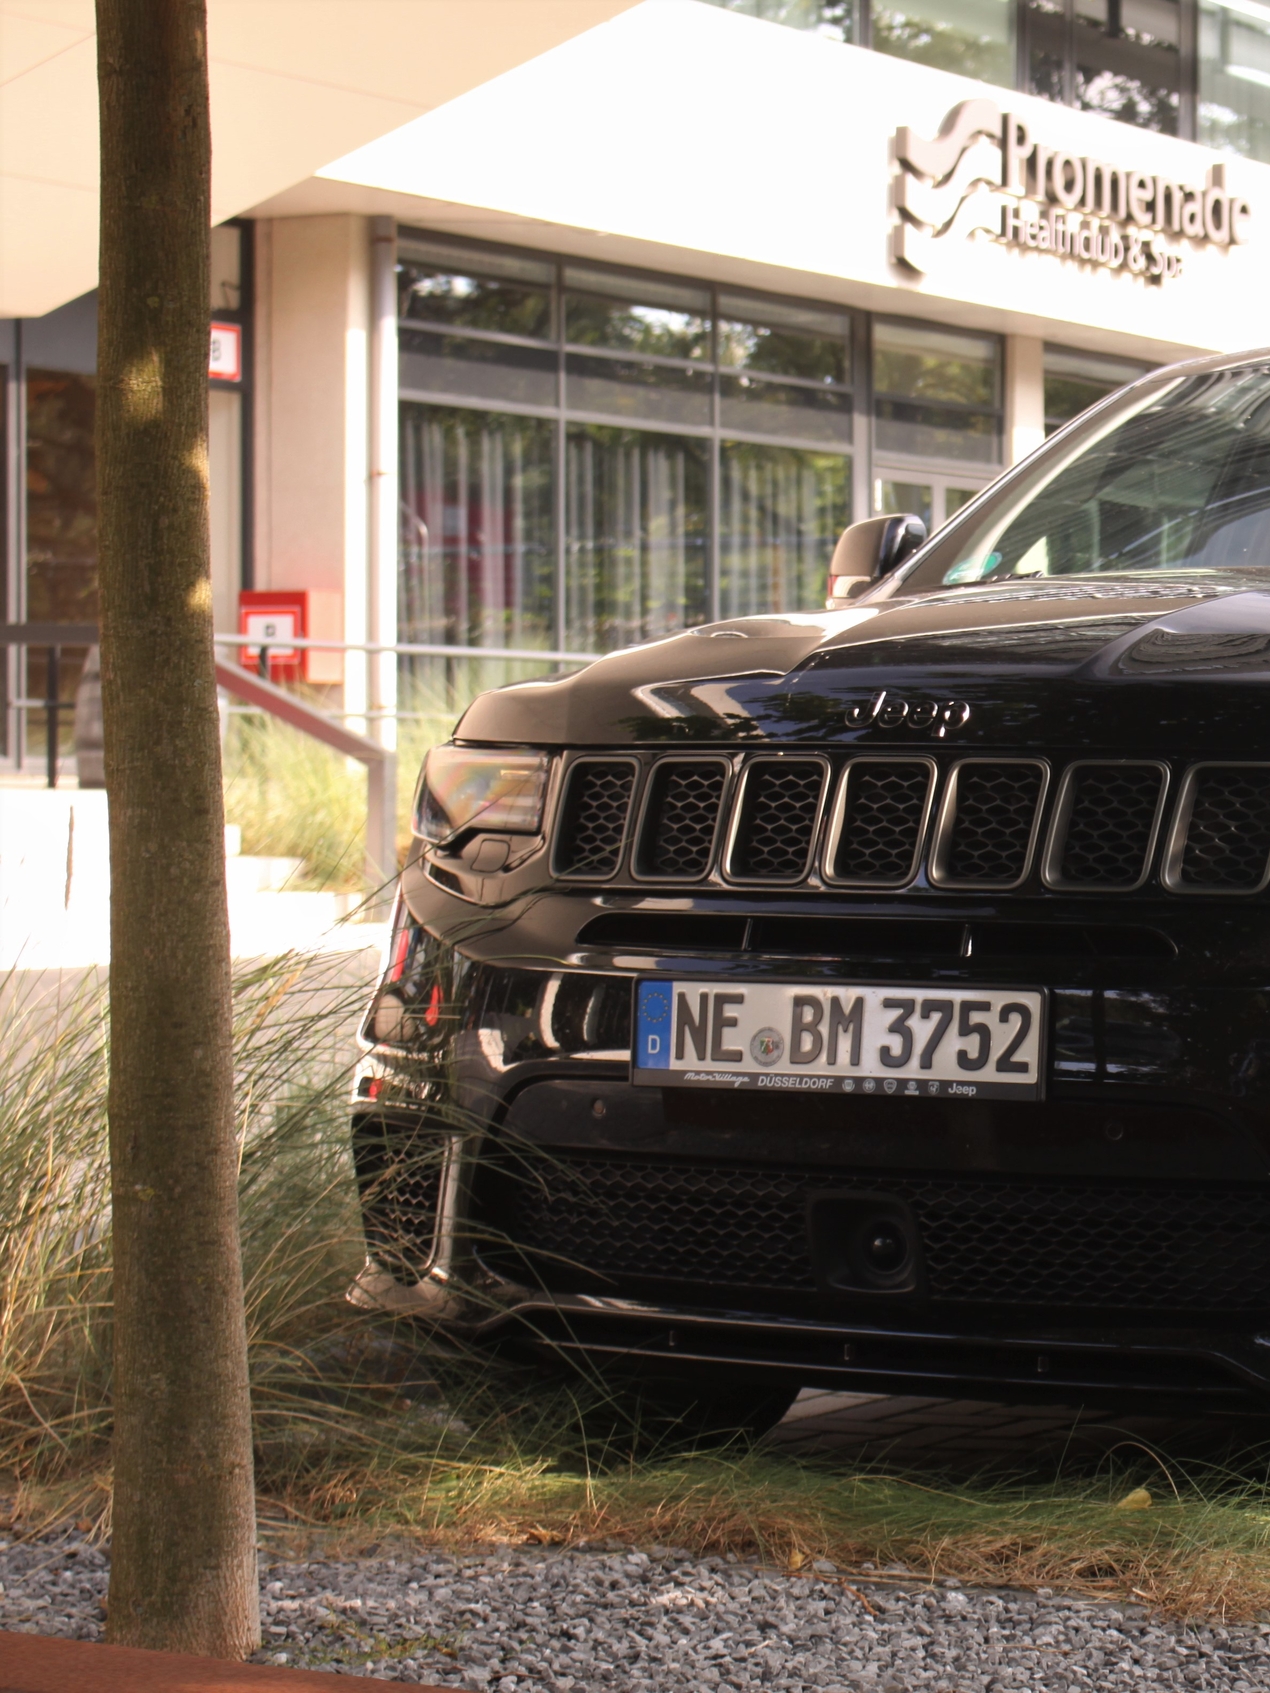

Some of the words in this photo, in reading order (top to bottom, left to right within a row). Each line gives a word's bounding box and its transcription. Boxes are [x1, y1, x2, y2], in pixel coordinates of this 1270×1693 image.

[1002, 113, 1251, 245] Promenade
[1002, 205, 1124, 268] Healthclub
[1127, 234, 1146, 273] &
[845, 691, 970, 738] Jeep
[647, 1034, 661, 1054] D
[676, 991, 744, 1062] NE
[790, 994, 864, 1066] BM
[879, 997, 1032, 1074] 3752
[757, 1074, 835, 1090] DÜSSELDORF
[948, 1082, 977, 1097] Jeep
